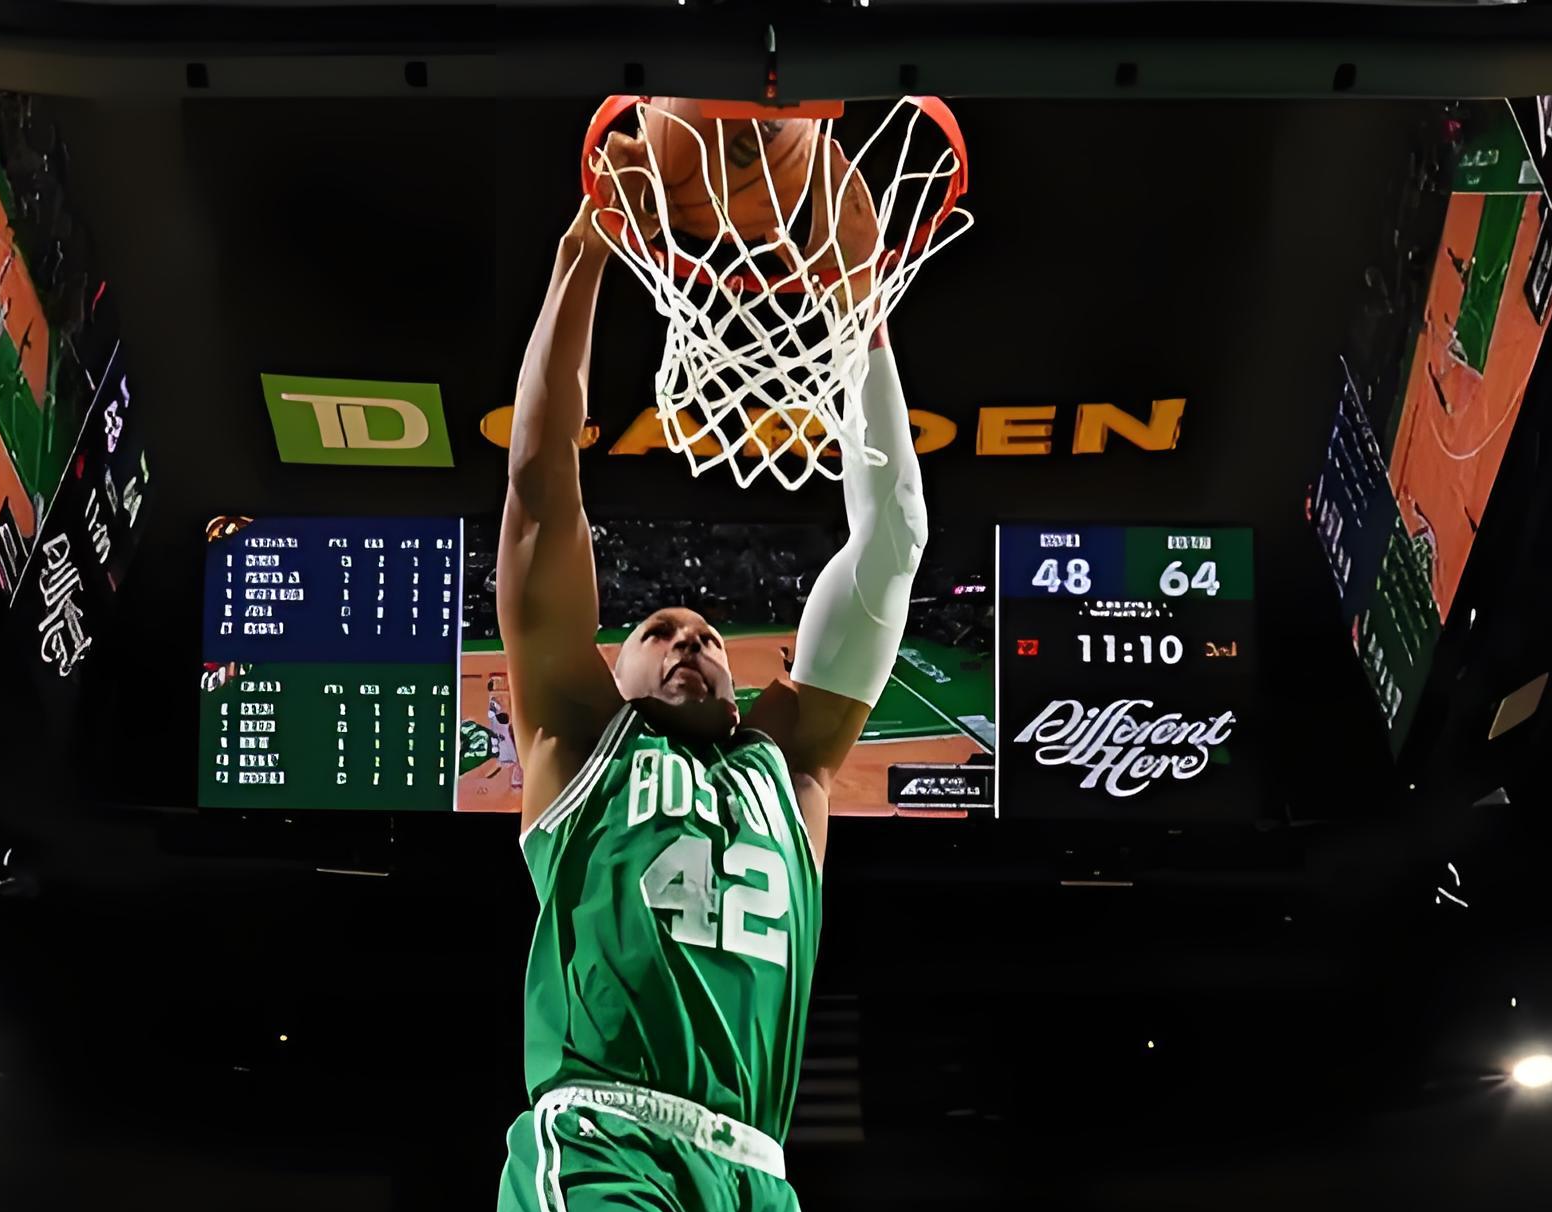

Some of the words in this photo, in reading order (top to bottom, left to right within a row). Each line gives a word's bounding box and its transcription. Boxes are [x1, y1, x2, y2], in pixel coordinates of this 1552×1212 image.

[280, 392, 429, 449] TD
[1031, 558, 1092, 595] 48
[1159, 561, 1220, 597] 64
[1077, 634, 1184, 664] 11:10
[1013, 699, 1237, 757] Different
[640, 834, 789, 973] 42
